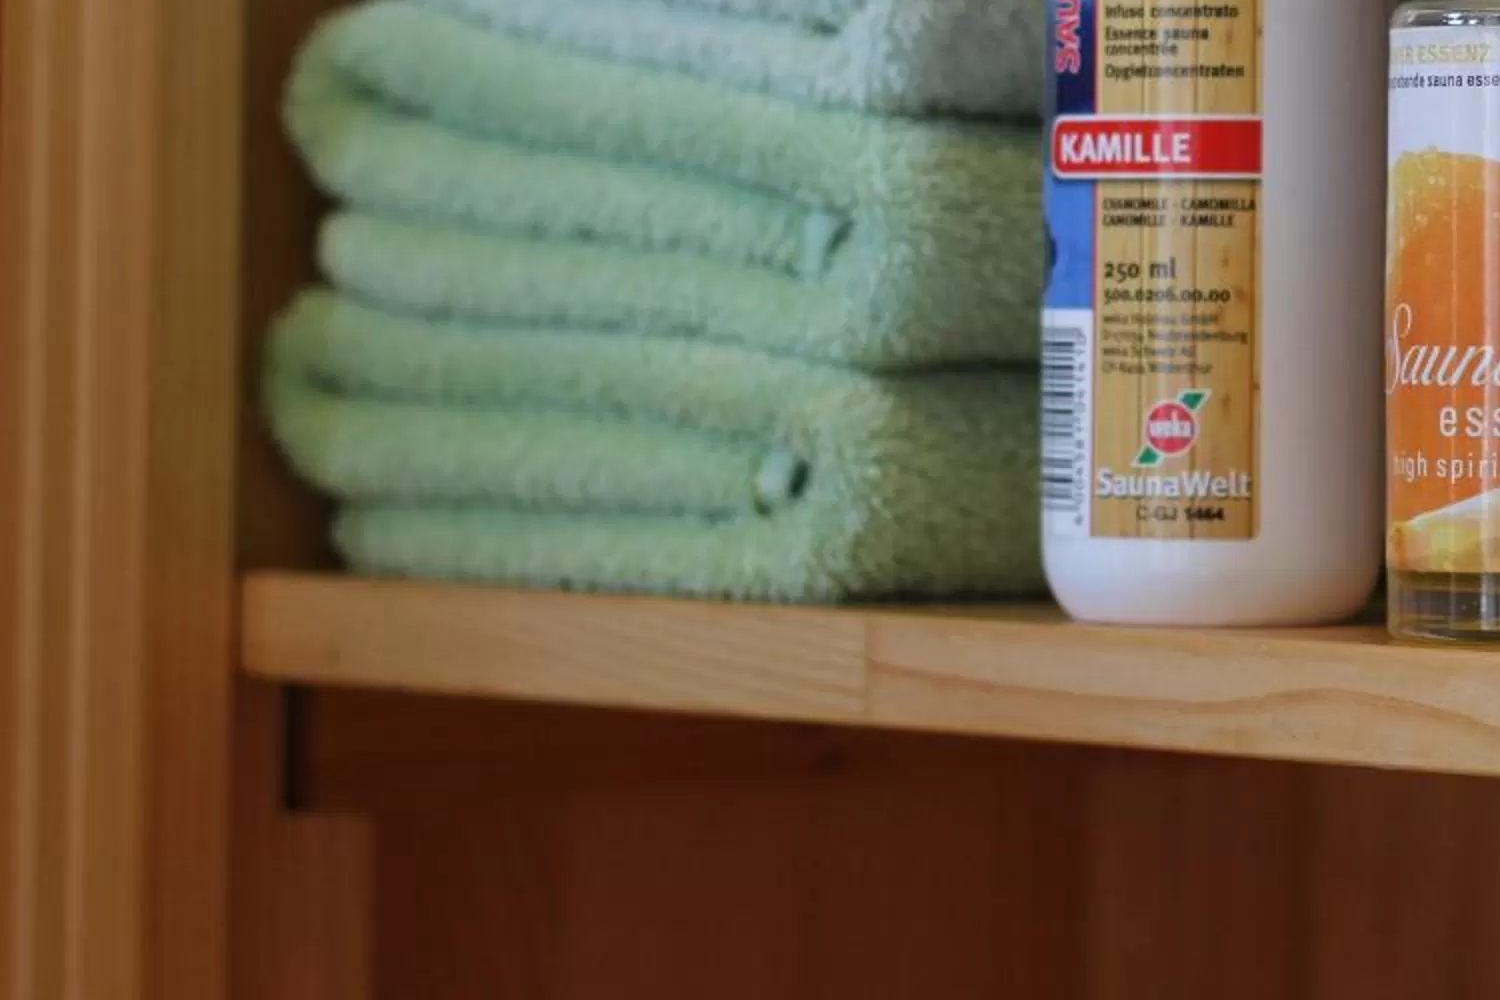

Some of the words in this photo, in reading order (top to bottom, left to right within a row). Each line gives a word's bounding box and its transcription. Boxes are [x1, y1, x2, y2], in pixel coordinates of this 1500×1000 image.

[1427, 73, 1463, 88] sauna
[1061, 132, 1192, 164] KAMILLE
[1104, 261, 1140, 282] 250
[1150, 257, 1176, 279] ml
[1096, 467, 1251, 498] SaunaWelt
